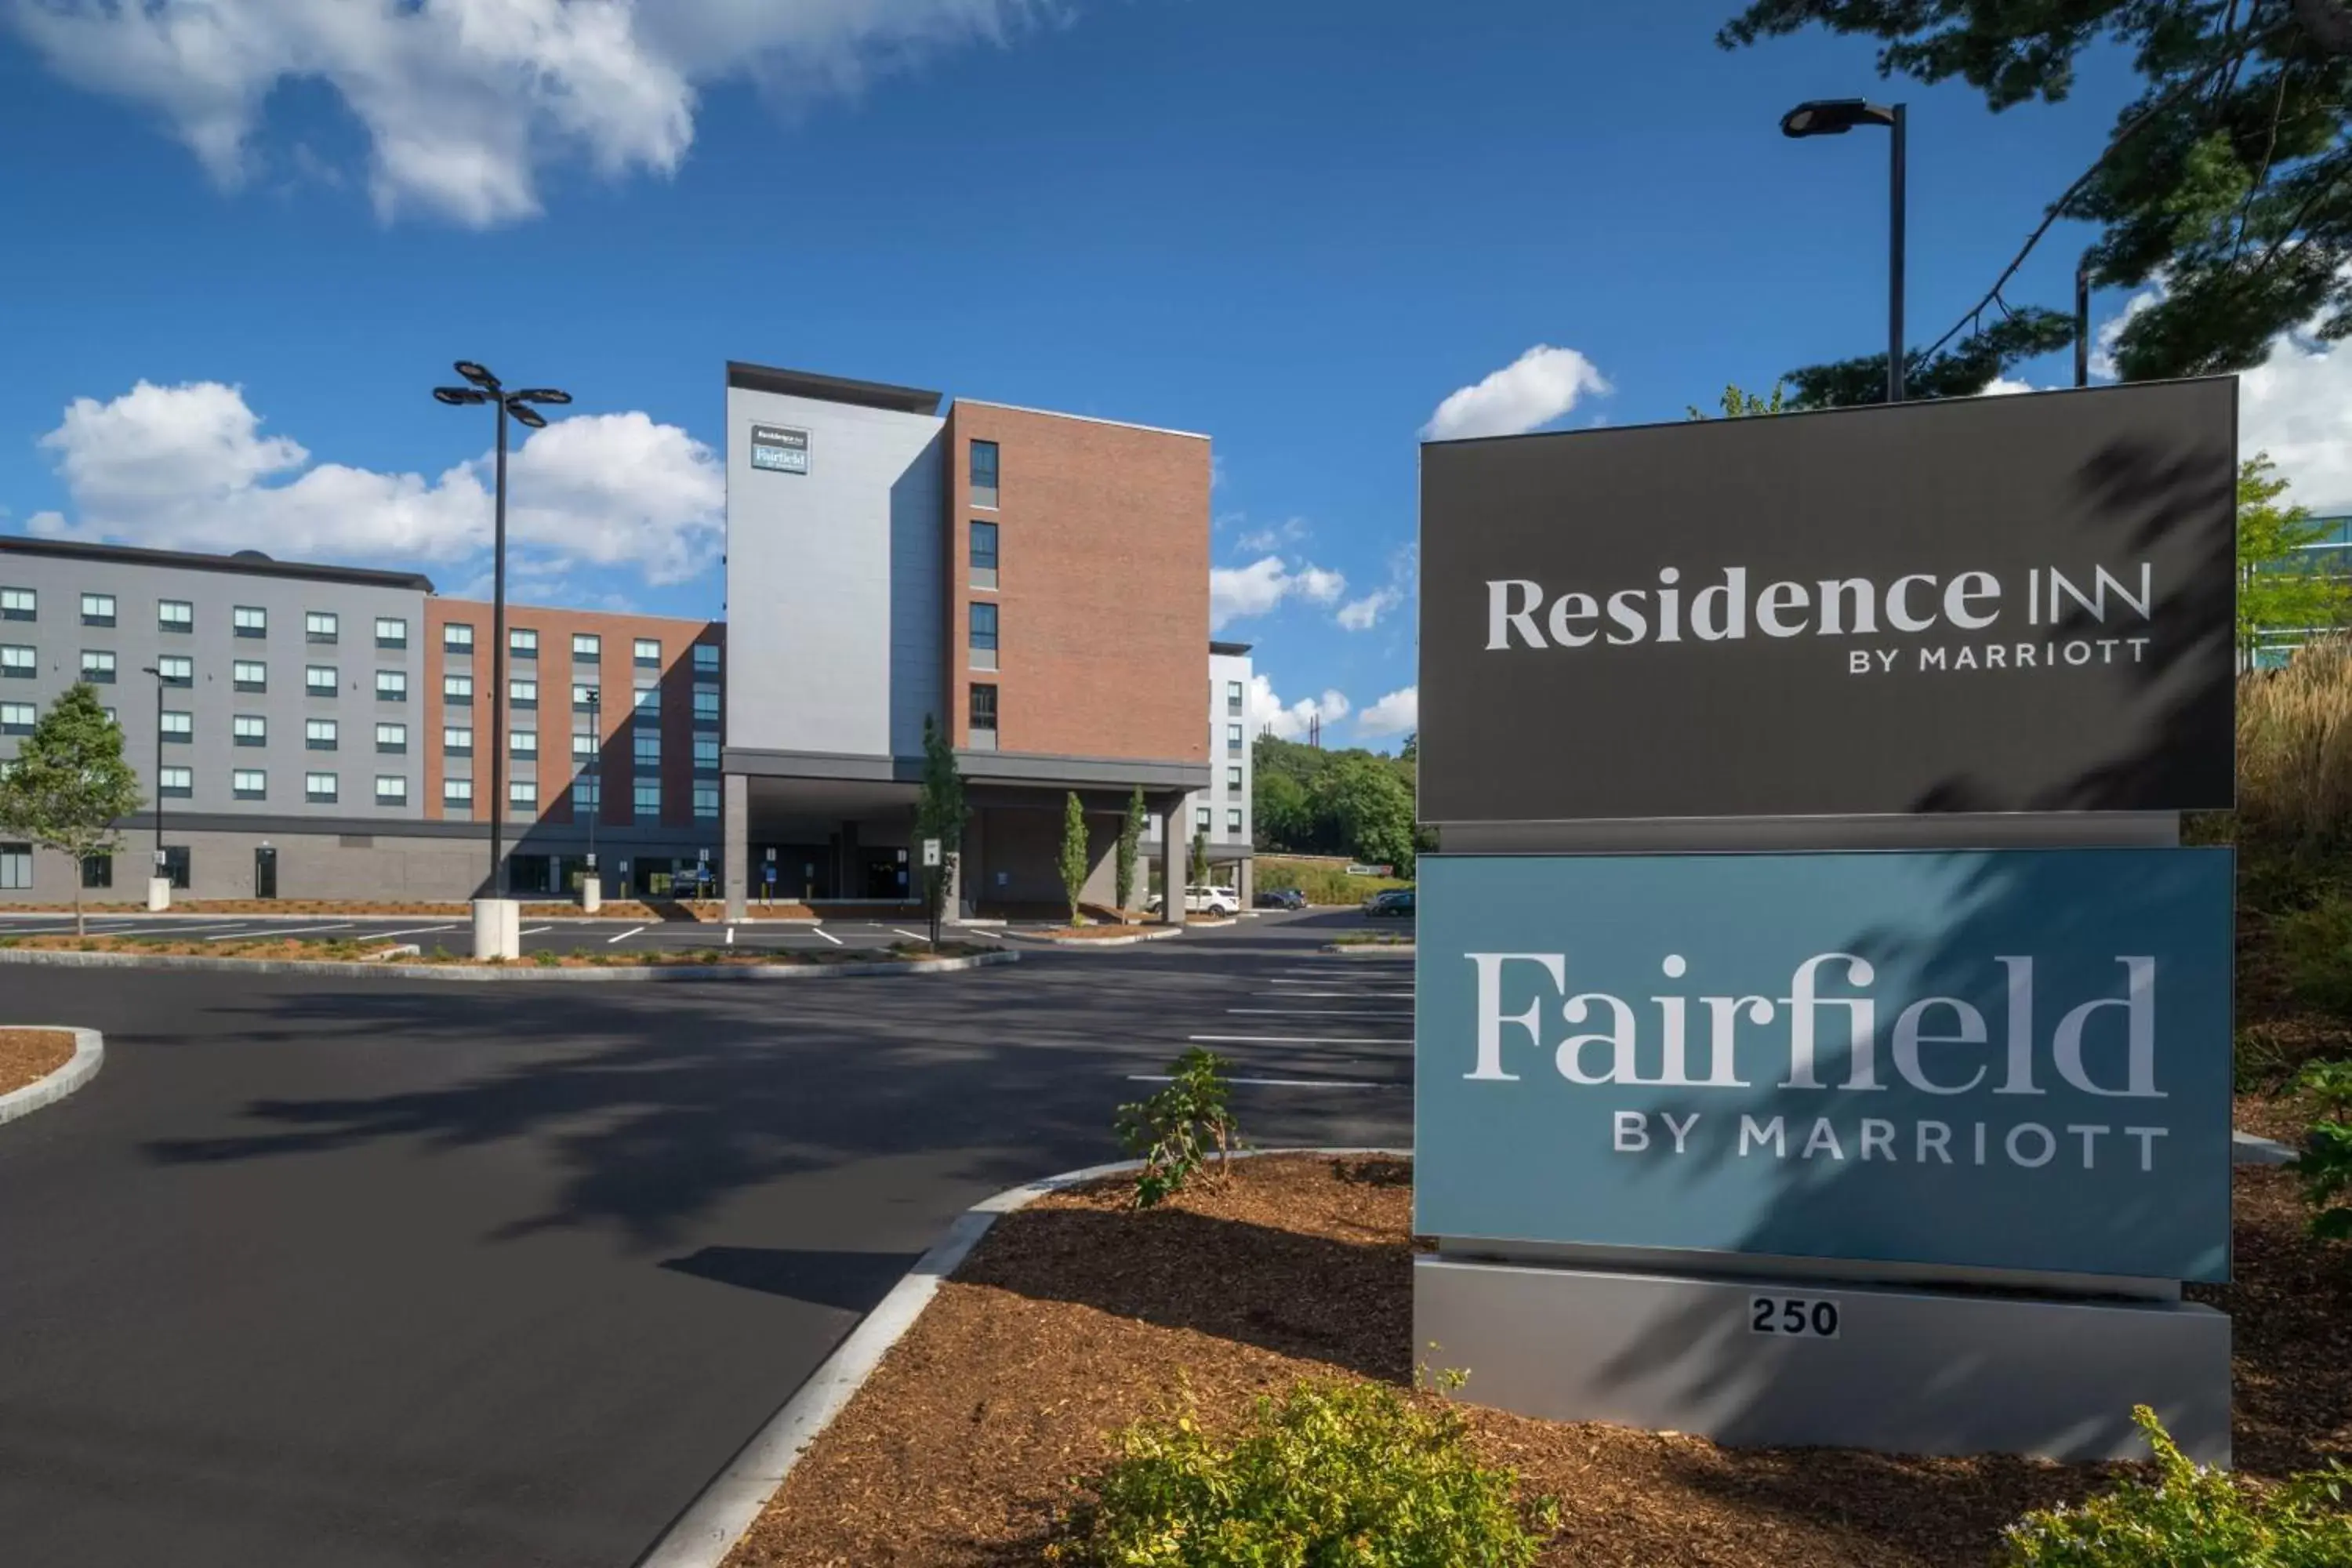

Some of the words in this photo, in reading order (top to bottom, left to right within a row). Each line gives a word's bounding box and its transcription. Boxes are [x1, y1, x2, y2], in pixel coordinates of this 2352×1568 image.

[1484, 566, 2002, 651] Residence
[2028, 561, 2151, 626] INN
[1849, 648, 1900, 674] BY
[1918, 637, 2150, 672] MARRIOTT
[1462, 952, 2169, 1098] Fairfield
[1613, 1110, 1700, 1154] BY
[1738, 1116, 2169, 1171] MARRIOTT
[1754, 1298, 1838, 1336] 250
